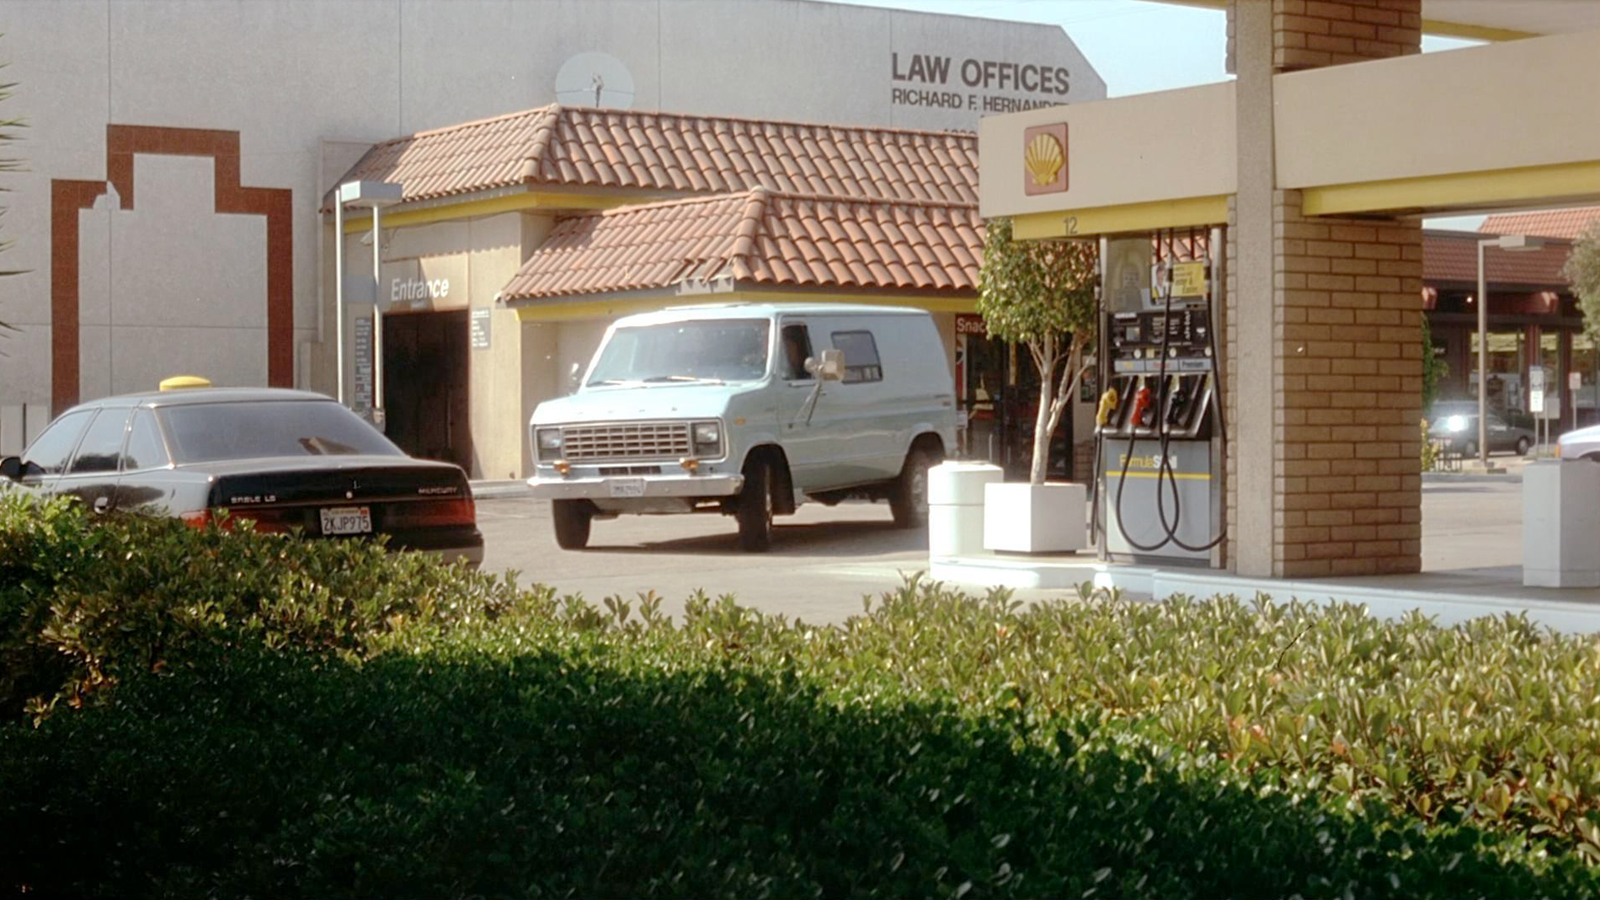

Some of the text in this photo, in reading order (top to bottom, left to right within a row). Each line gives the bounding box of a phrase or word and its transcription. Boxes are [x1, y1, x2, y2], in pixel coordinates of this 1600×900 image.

[892, 52, 1070, 95] LAW OFFICES
[892, 88, 1070, 113] RICHARD F. HERNAND
[1063, 216, 1078, 236] 12
[391, 277, 450, 301] Entrance
[957, 317, 987, 333] Snac
[323, 515, 370, 532] 2KJP975
